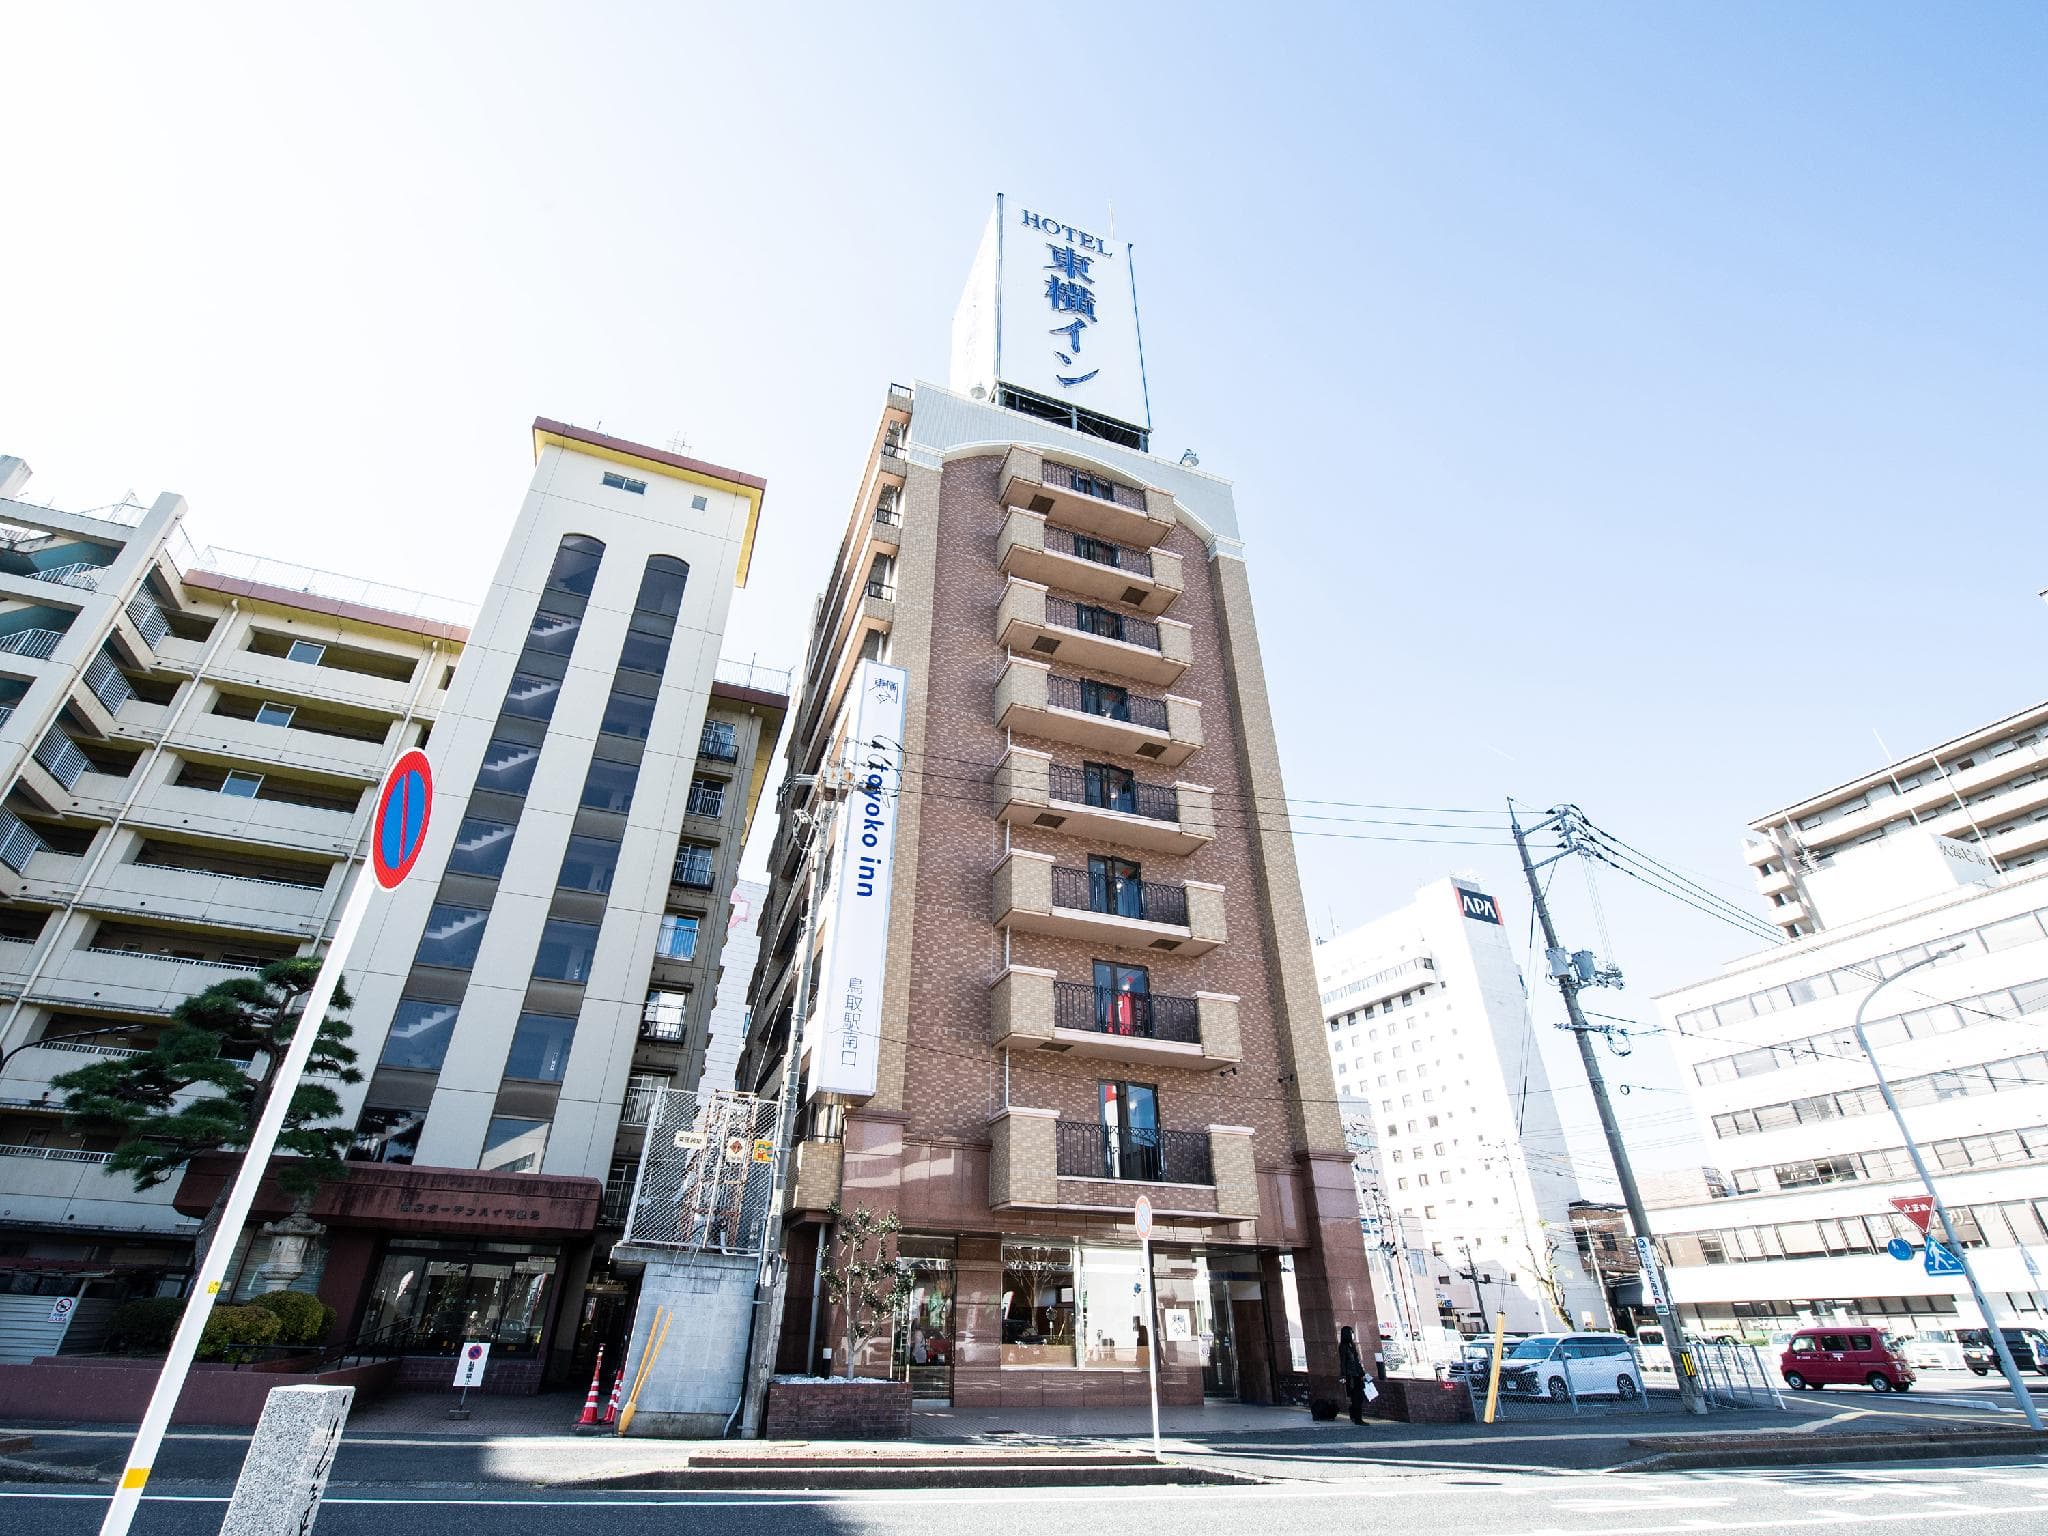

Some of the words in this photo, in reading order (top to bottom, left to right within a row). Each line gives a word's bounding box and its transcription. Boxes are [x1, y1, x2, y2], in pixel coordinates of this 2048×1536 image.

[1021, 208, 1113, 258] HOTEL
[1043, 243, 1100, 388] 東横イン
[862, 763, 888, 848] toyoko
[856, 856, 882, 897] inn
[1463, 895, 1497, 919] APA
[841, 977, 864, 1067] 鳥取駅南口
[1903, 1203, 1931, 1213] 止まれ
